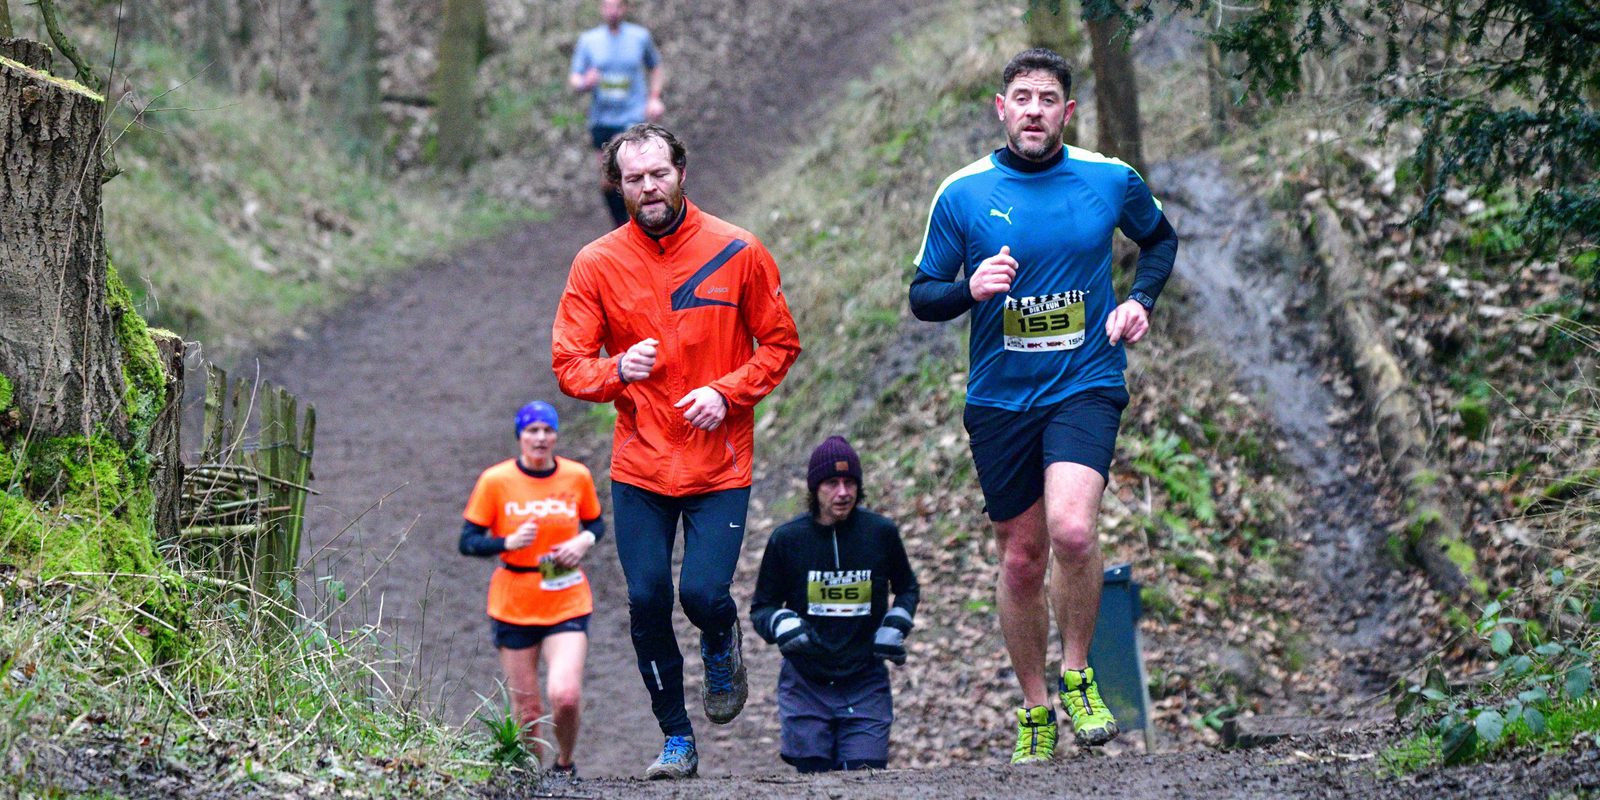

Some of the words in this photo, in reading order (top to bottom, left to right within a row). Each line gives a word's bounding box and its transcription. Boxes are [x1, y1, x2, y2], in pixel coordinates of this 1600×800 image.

[1029, 304, 1044, 314] DIRT
[1045, 302, 1060, 310] RUN
[1018, 314, 1070, 332] 153
[504, 498, 577, 518] rugby
[820, 588, 859, 600] 166
